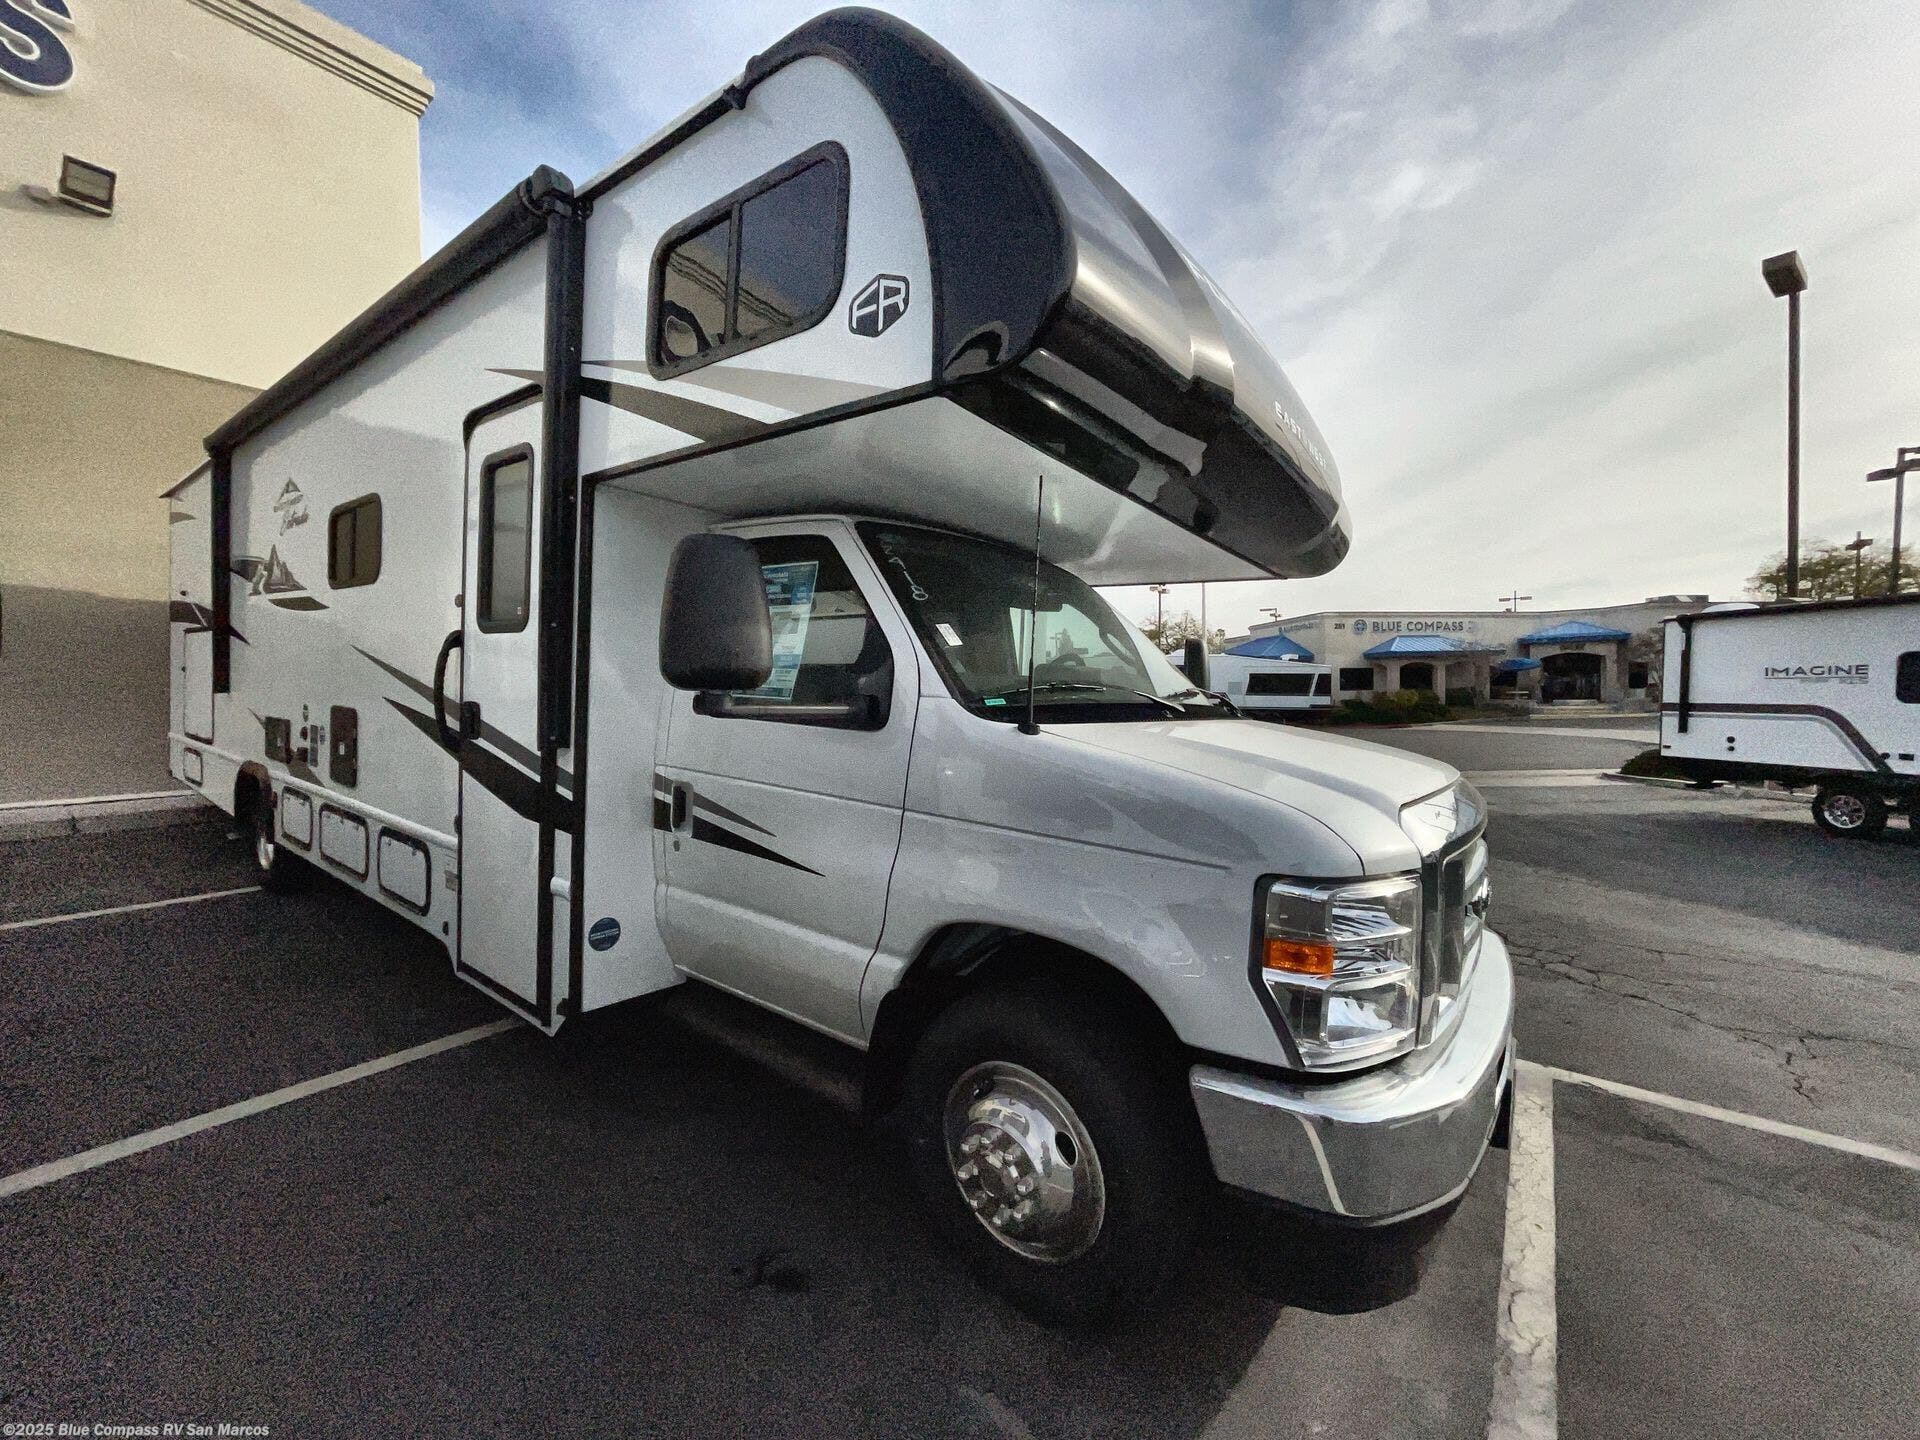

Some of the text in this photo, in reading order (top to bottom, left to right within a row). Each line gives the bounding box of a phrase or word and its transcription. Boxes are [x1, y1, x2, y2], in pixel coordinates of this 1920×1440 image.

[1372, 621, 1402, 632] BLUE
[1406, 621, 1464, 632] COMPASS
[1764, 664, 1870, 677] IMAGINE
